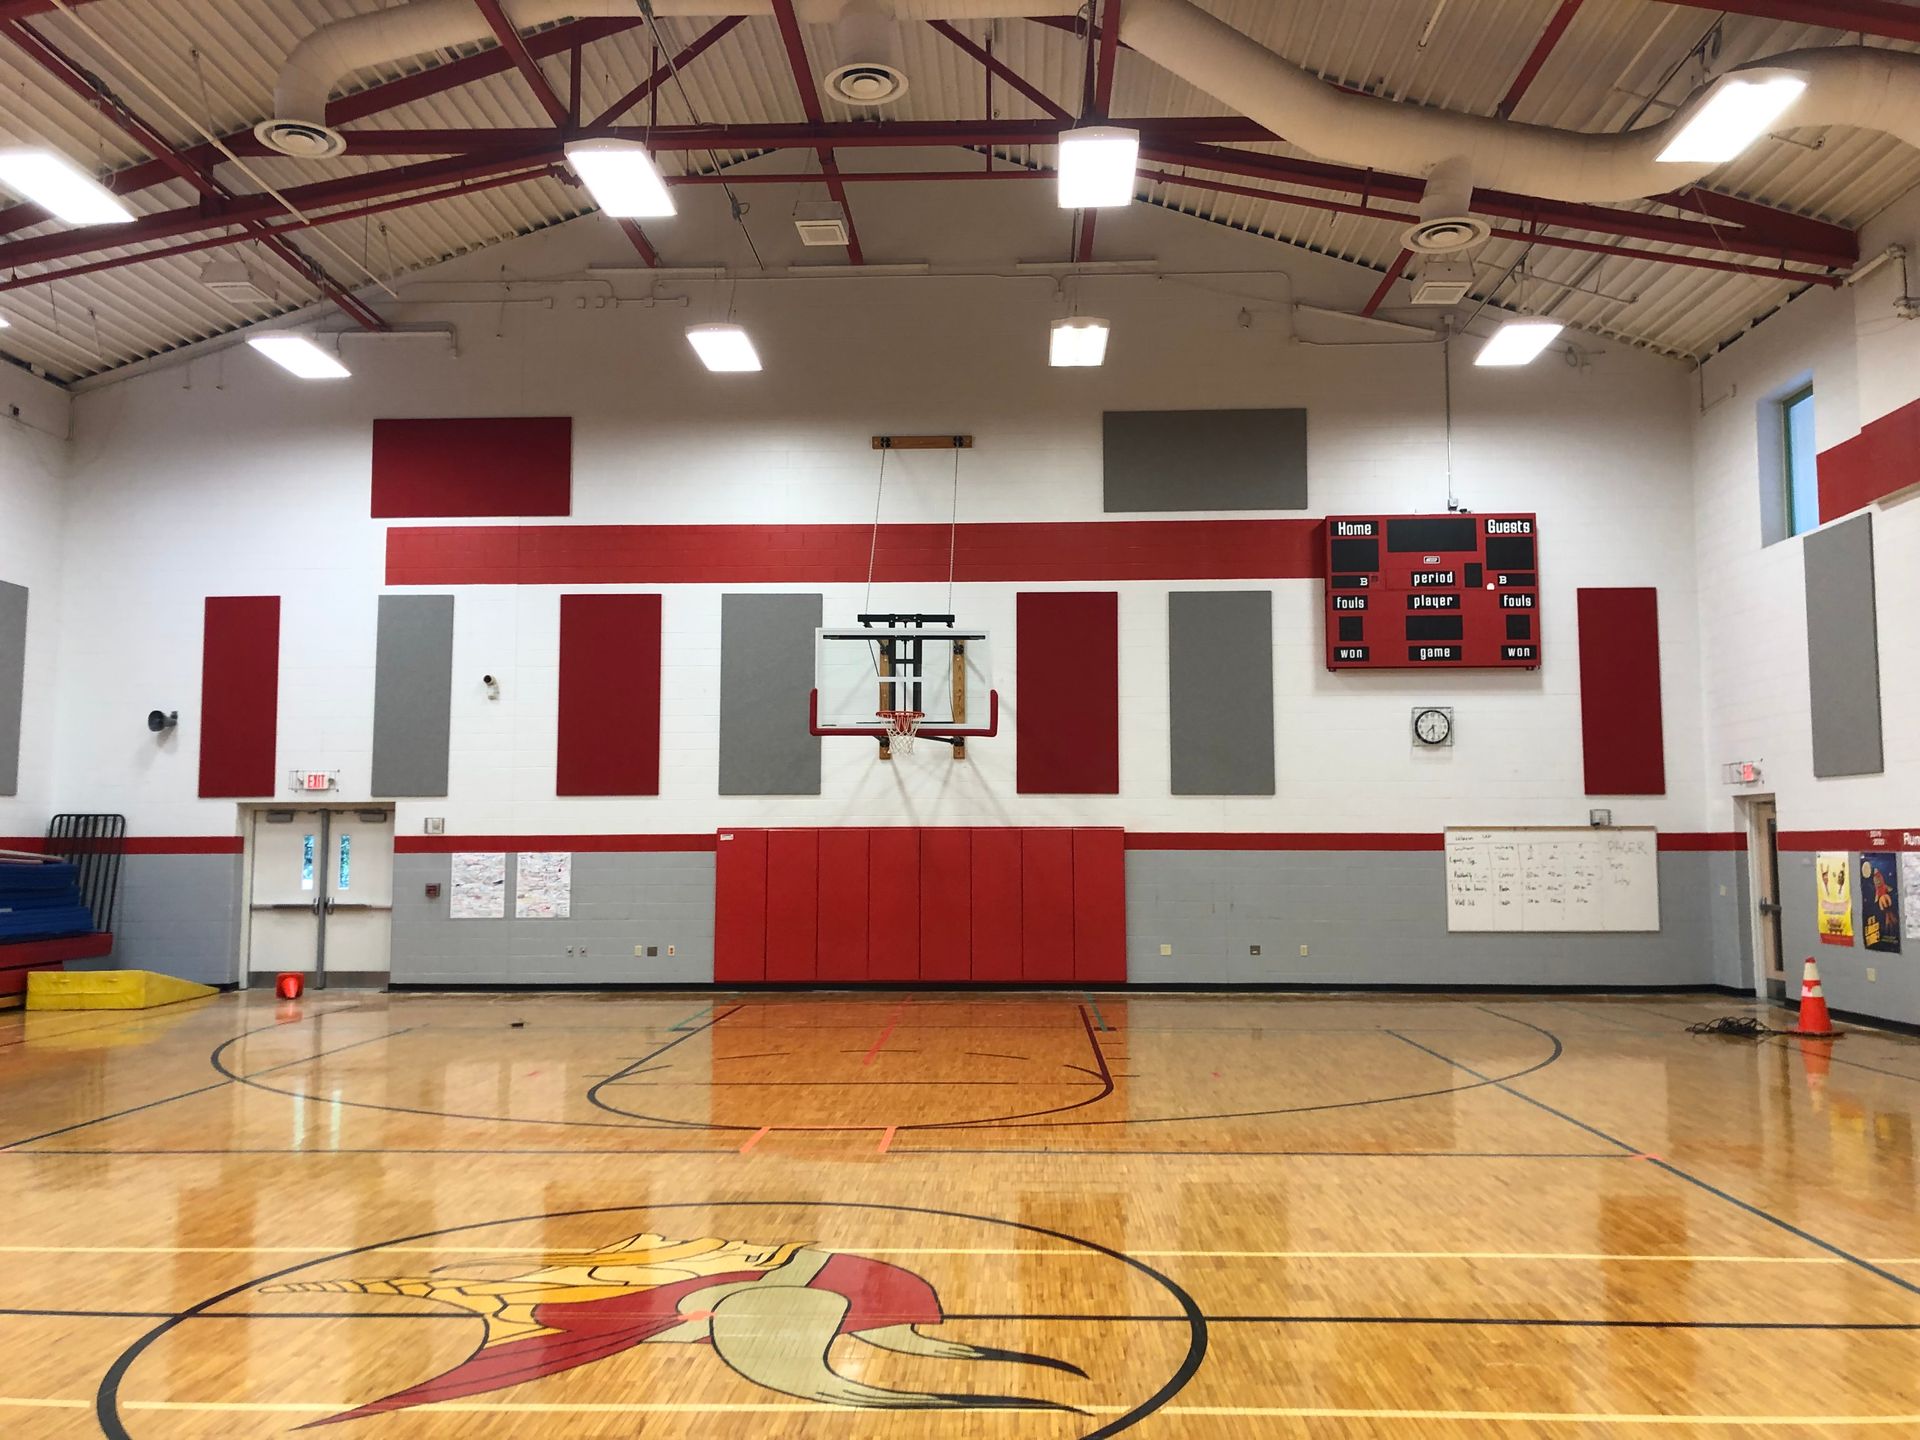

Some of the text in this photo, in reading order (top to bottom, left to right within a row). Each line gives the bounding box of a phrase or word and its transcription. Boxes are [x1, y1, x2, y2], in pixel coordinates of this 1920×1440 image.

[1338, 521, 1372, 536] Home
[1488, 519, 1531, 534] Guests
[1360, 577, 1368, 586] B
[1413, 571, 1453, 586] period
[1499, 575, 1507, 585] B
[1336, 597, 1365, 609] fouls
[1413, 594, 1453, 609] player
[1503, 594, 1532, 607] fouls
[1340, 649, 1363, 659] won
[1420, 647, 1450, 661] game
[1507, 648, 1530, 657] won
[307, 774, 326, 788] EXIT
